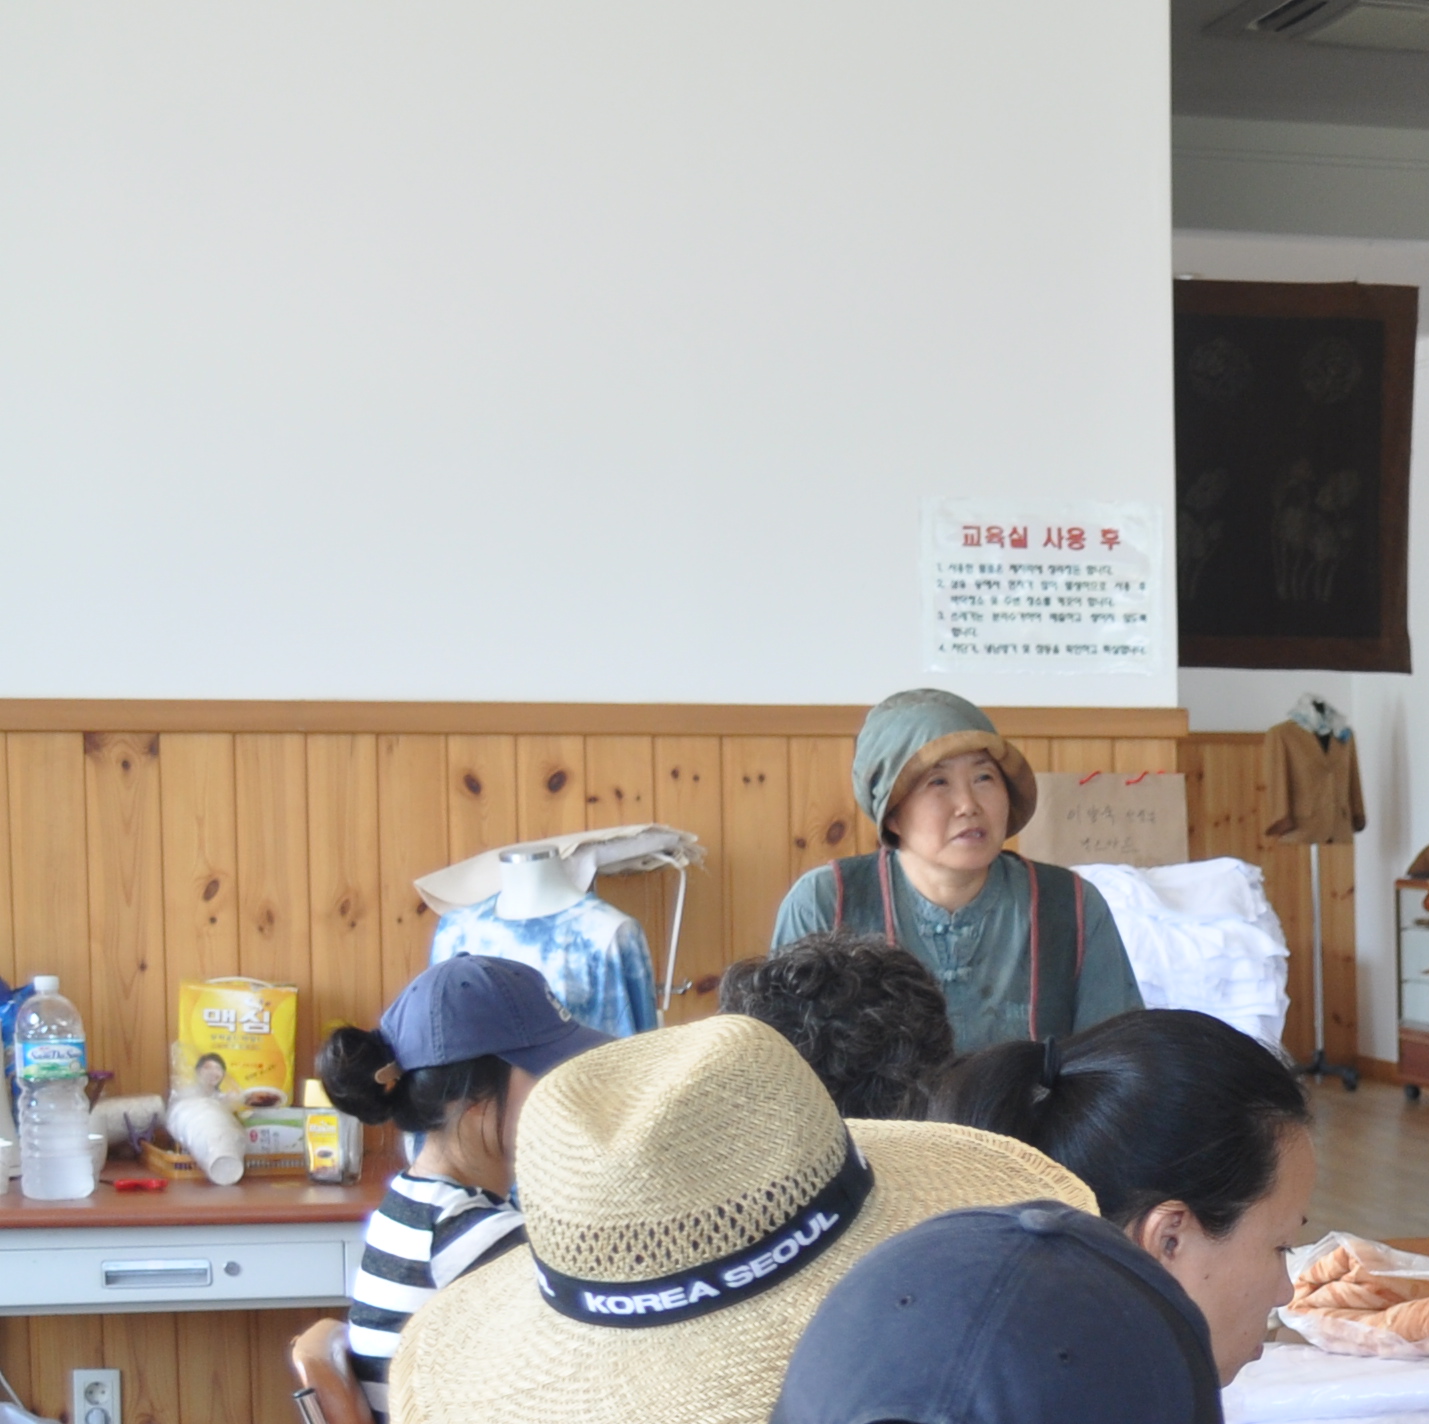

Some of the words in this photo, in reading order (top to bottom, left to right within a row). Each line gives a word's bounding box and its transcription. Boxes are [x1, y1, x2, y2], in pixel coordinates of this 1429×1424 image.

[962, 525, 1028, 549] 교육실
[1043, 526, 1086, 550] 사용
[1101, 528, 1121, 551] 후
[203, 1006, 272, 1034] 맥심
[584, 1281, 720, 1315] KOREA
[723, 1211, 839, 1288] SEOUL
